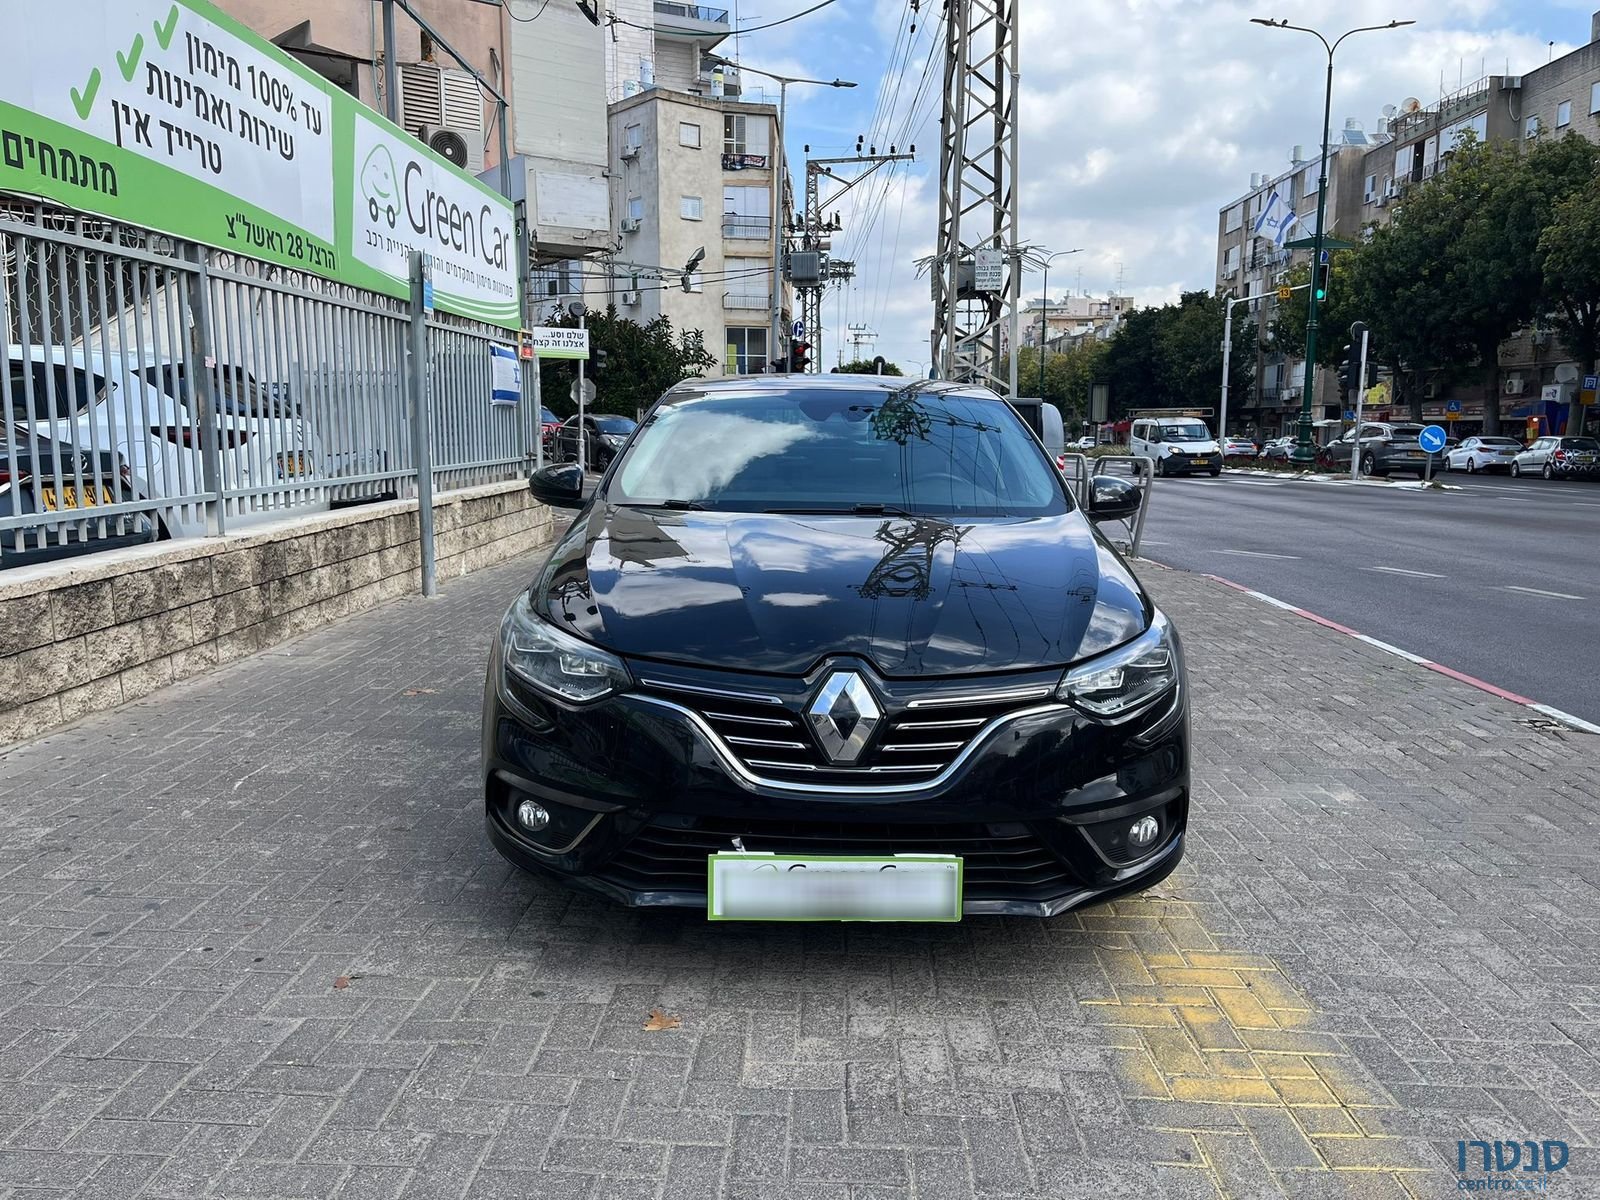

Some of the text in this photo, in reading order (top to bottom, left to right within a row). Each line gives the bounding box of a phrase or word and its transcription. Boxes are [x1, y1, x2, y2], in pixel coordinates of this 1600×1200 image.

[185, 31, 322, 136] עד 100% מימון
[146, 61, 294, 161] שירות ואמינות
[111, 99, 223, 174] טרייד אין
[2, 129, 118, 197] מתמחים
[405, 161, 509, 272] Green Car
[286, 232, 304, 260] 28
[306, 236, 336, 270] הרצל
[366, 229, 384, 250] רכב
[446, 261, 475, 284] מתקדמים
[1280, 289, 1289, 297] 13
[533, 339, 550, 348] קצת
[563, 339, 584, 347] אצלנו
[566, 331, 584, 339] שלם
